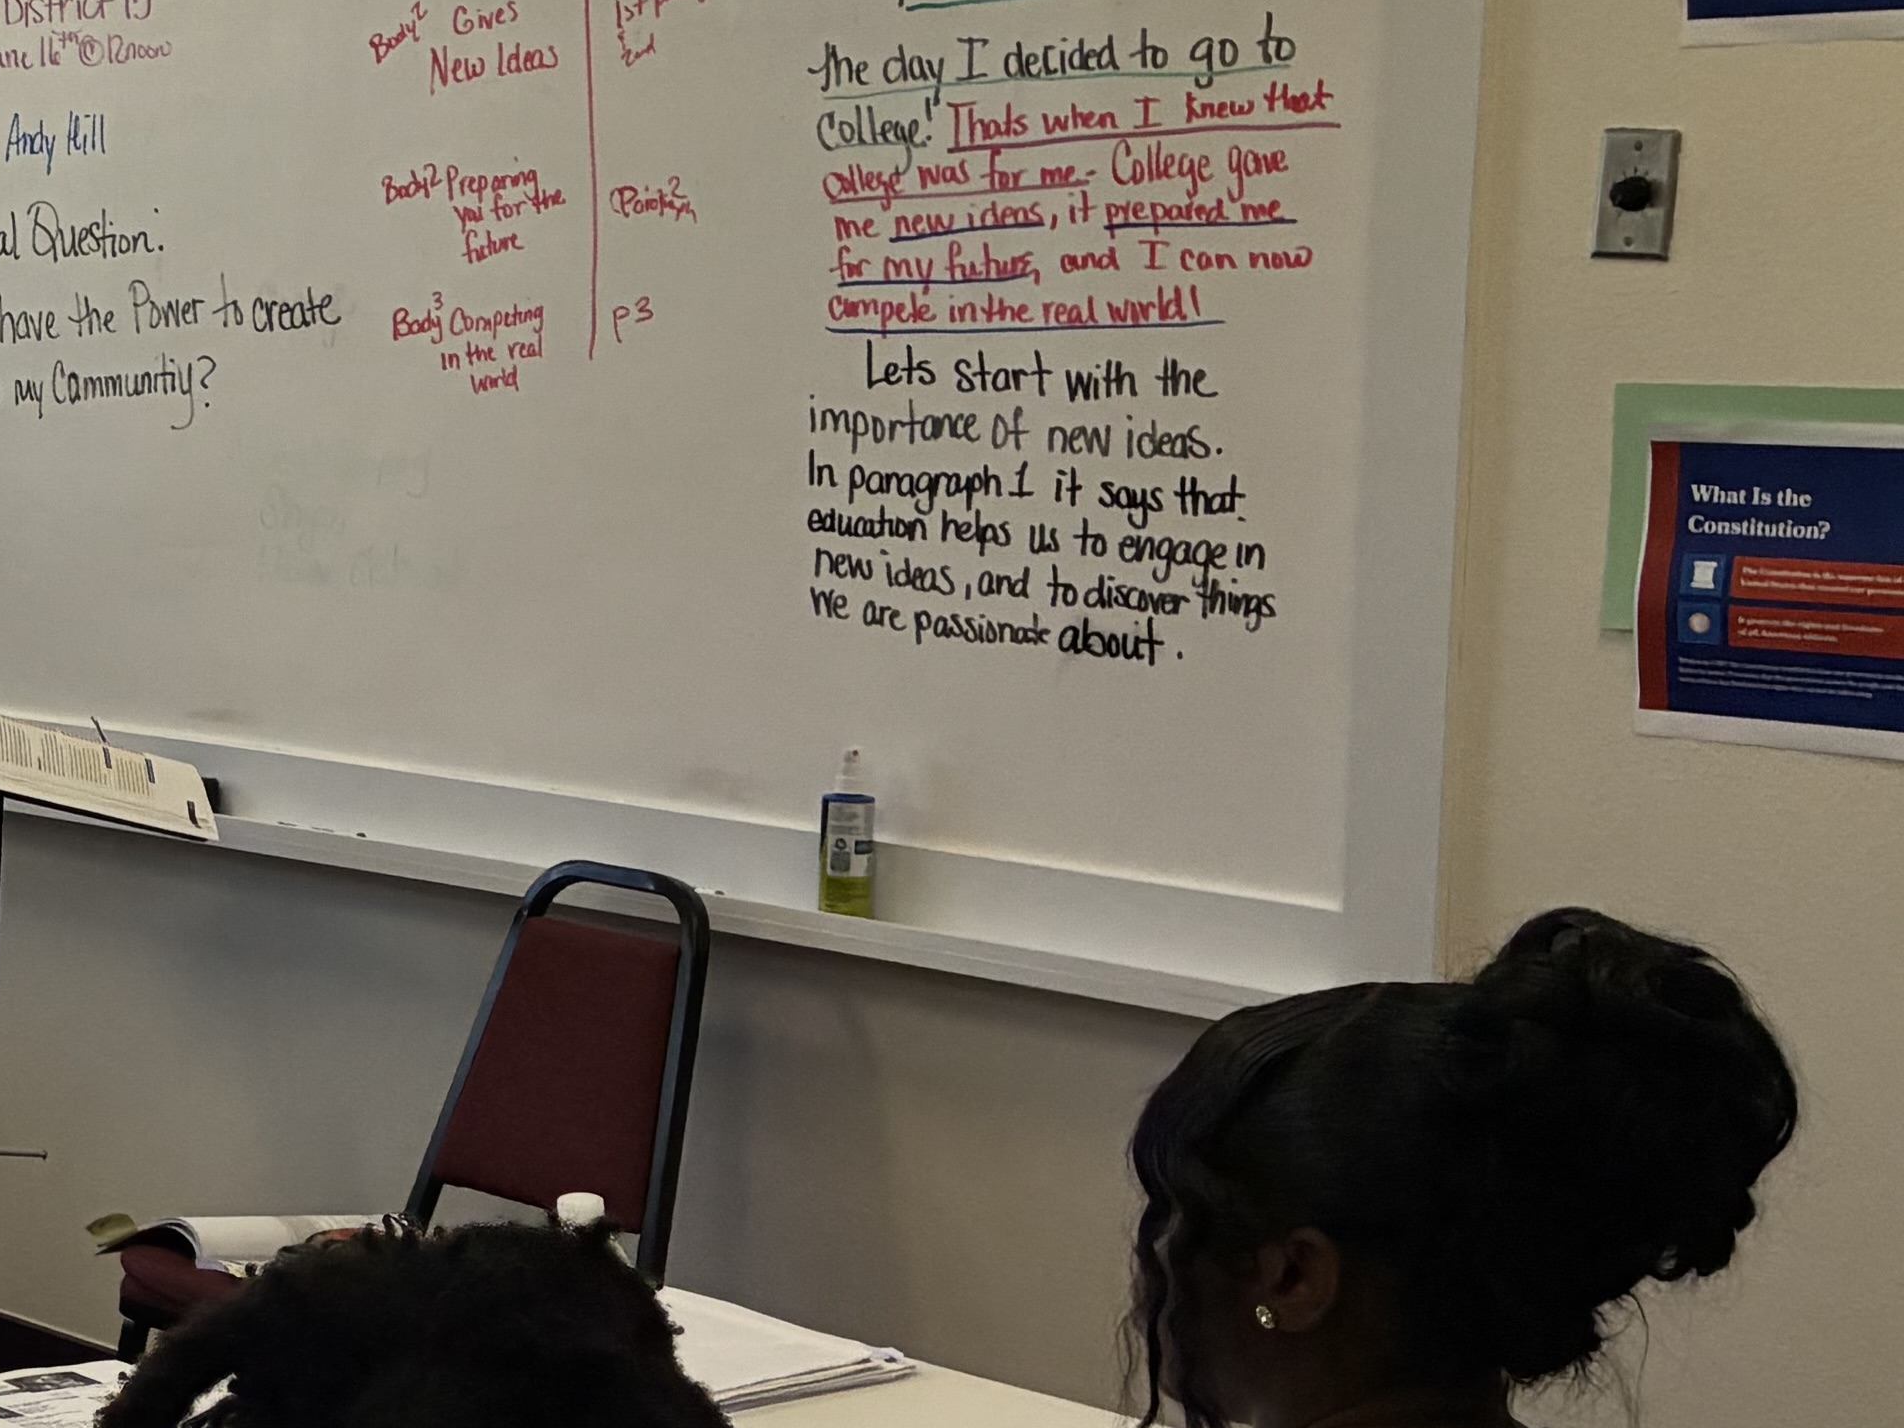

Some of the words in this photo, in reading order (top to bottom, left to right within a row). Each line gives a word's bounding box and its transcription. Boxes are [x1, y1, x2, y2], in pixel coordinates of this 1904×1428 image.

[452, 0, 520, 36] Gives
[430, 47, 486, 96] New
[497, 41, 560, 78] Ideas
[882, 44, 946, 106] day
[954, 37, 989, 83] I
[1004, 35, 1121, 84] decided
[1129, 27, 1169, 70] to
[1189, 35, 1240, 90] go
[1257, 10, 1297, 64] to
[1042, 102, 1118, 132] when
[1133, 96, 1163, 130] I
[1263, 77, 1335, 113] that
[6, 112, 56, 176] Andy
[67, 110, 106, 156] Hill
[917, 160, 970, 191] was
[980, 148, 1026, 190] for
[1110, 140, 1215, 198] College
[835, 216, 881, 241] me
[894, 213, 955, 238] new
[1068, 190, 1098, 222] it
[1104, 199, 1226, 239] prepared
[1240, 196, 1283, 222] me
[829, 248, 873, 281] for
[883, 256, 935, 298] my
[1060, 246, 1120, 273] and
[1137, 239, 1170, 270] I
[1180, 248, 1238, 270] can
[1249, 243, 1314, 269] now
[68, 291, 117, 338] the
[212, 272, 244, 328] to
[977, 290, 1035, 324] the
[1044, 291, 1099, 325] real
[465, 339, 498, 363] the
[507, 332, 543, 360] real
[866, 339, 937, 390] Lets
[1065, 356, 1138, 402] with
[1156, 356, 1219, 398] the
[14, 378, 44, 420] my
[470, 364, 520, 395] world
[809, 394, 981, 453] importance
[1047, 422, 1112, 458] new
[808, 449, 838, 489] In
[849, 464, 1003, 516] paragraph
[1055, 468, 1083, 507] it
[1098, 484, 1165, 530] says
[1691, 484, 1748, 506] What
[1751, 486, 1772, 508] Is
[1776, 487, 1813, 509] the
[807, 505, 929, 542] education
[940, 509, 1012, 557] helps
[1029, 523, 1062, 556] us
[1073, 517, 1108, 557] to
[1118, 534, 1228, 585] engage
[1687, 515, 1832, 540] Constitution?
[814, 546, 875, 580] new
[977, 566, 1030, 599] and
[1047, 564, 1078, 608] to
[1083, 574, 1190, 616] discover
[1193, 576, 1278, 631] things
[862, 603, 908, 632] are
[914, 611, 1050, 646] passionate
